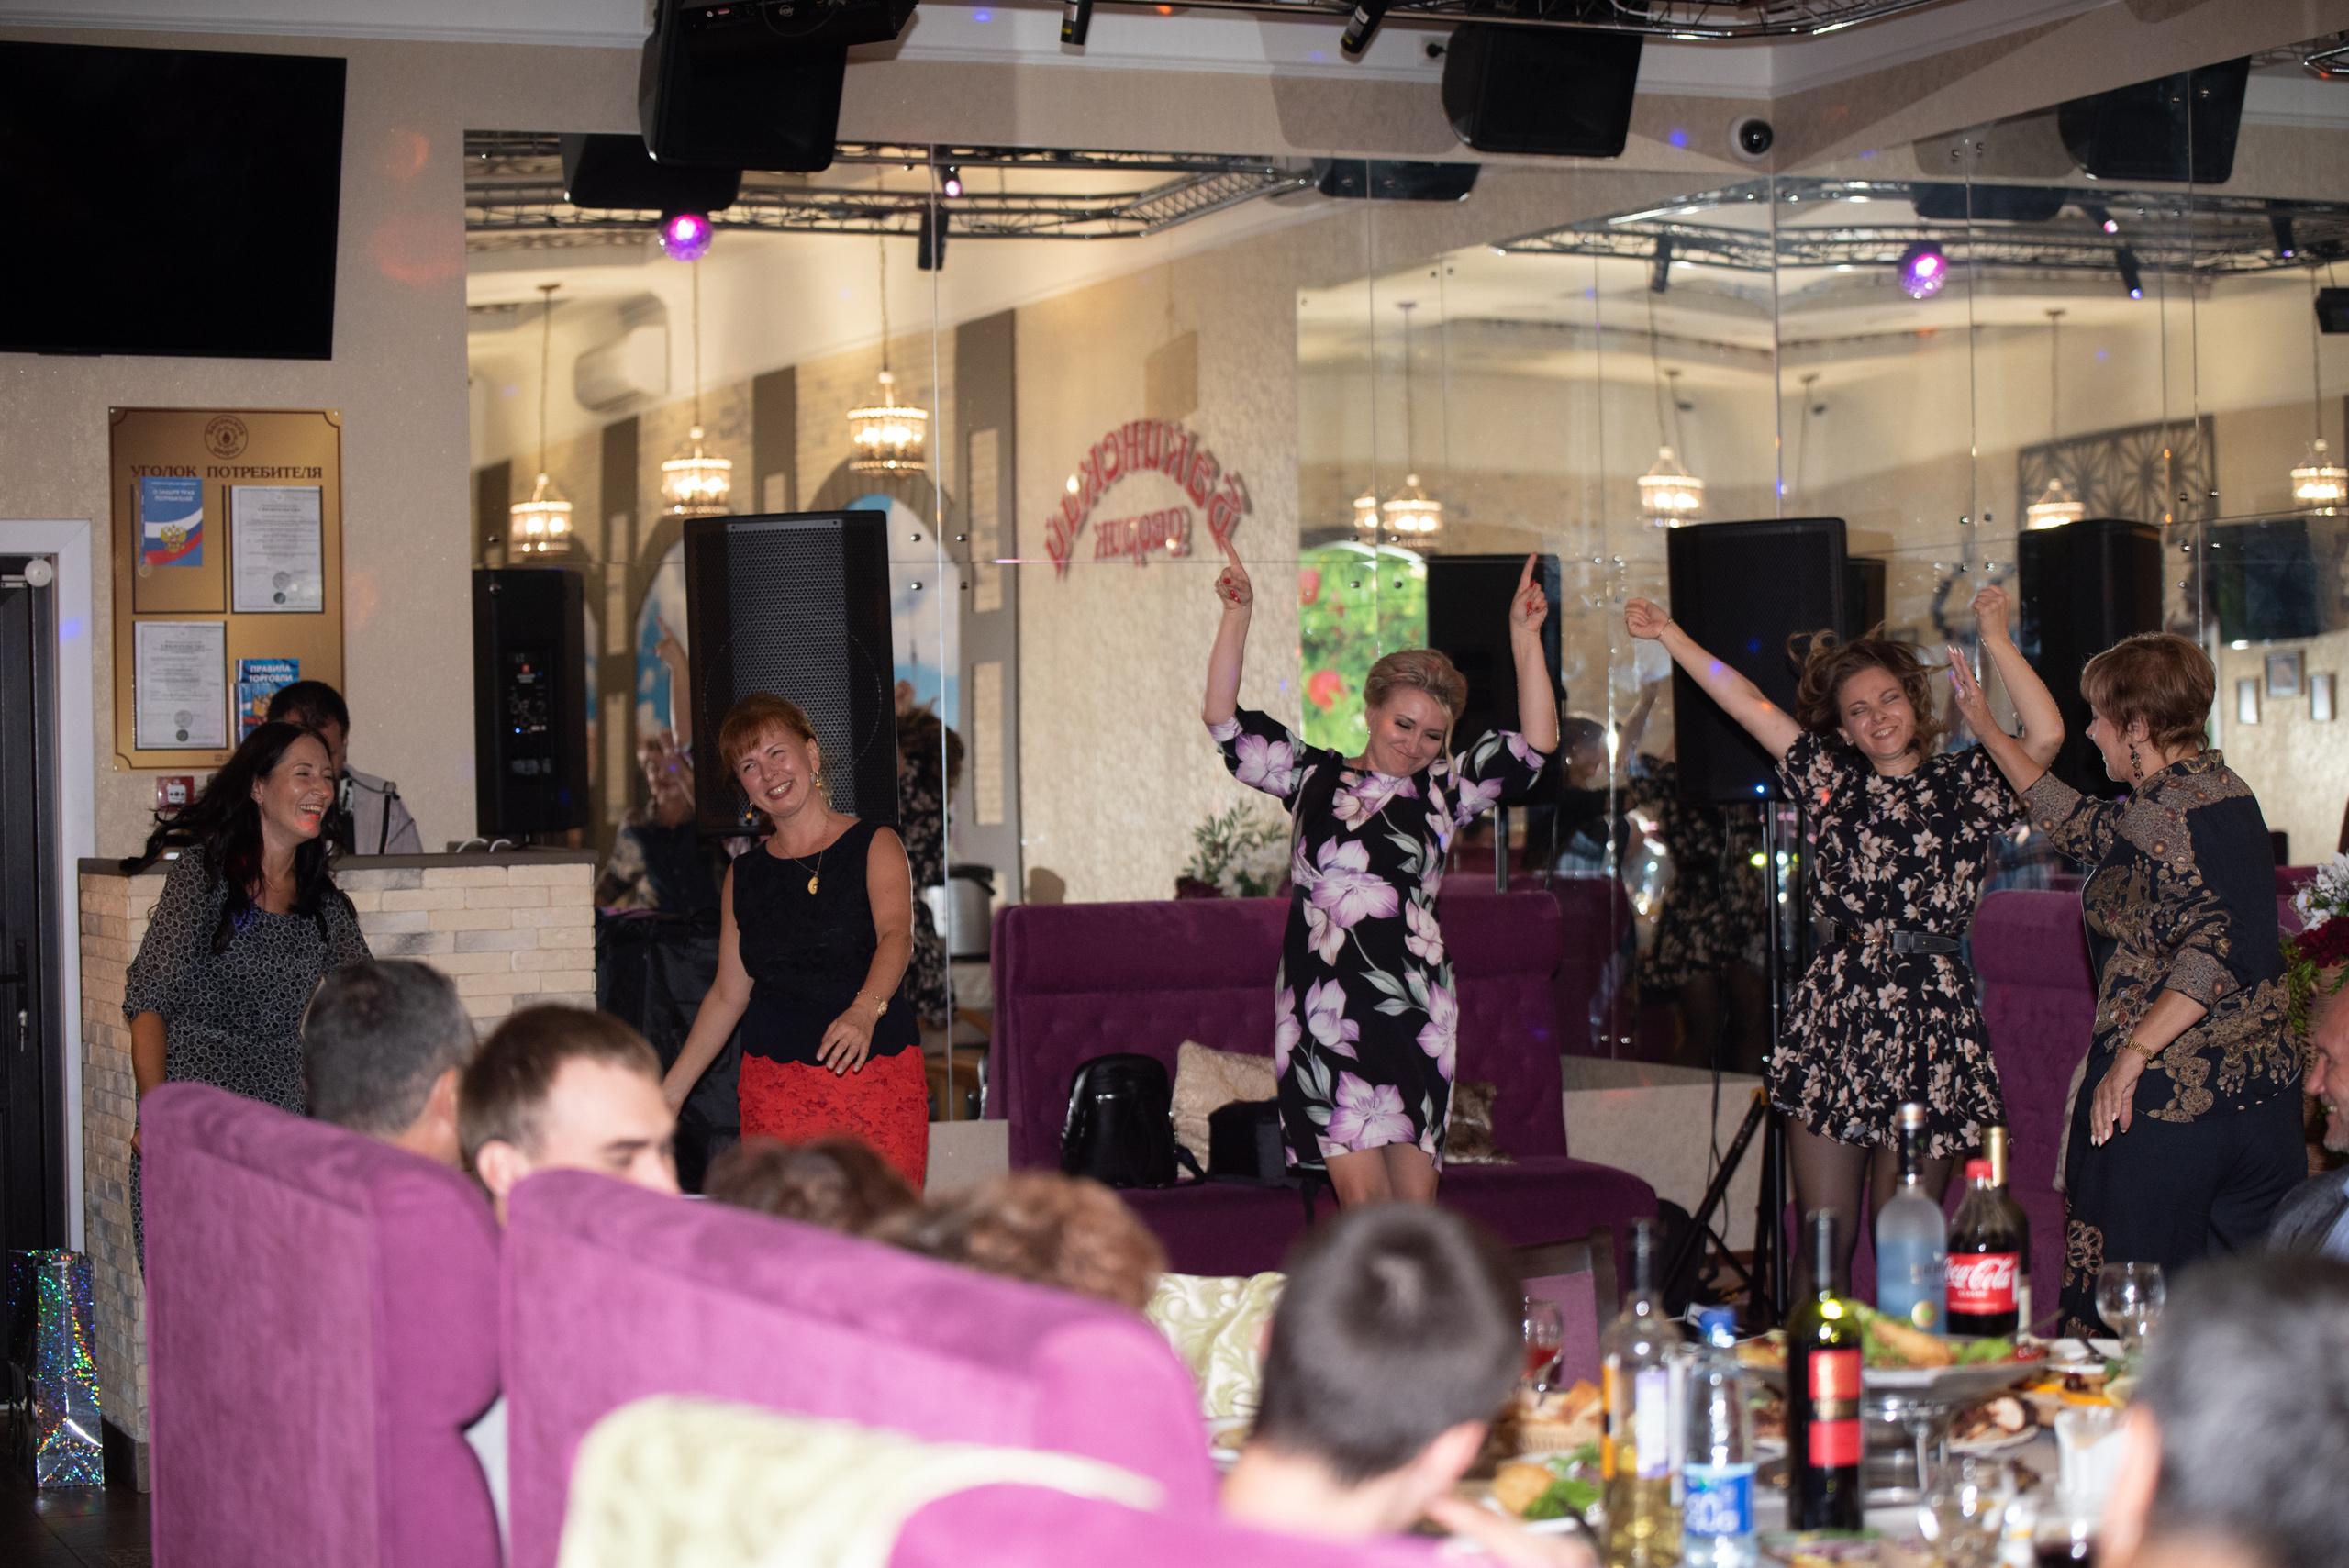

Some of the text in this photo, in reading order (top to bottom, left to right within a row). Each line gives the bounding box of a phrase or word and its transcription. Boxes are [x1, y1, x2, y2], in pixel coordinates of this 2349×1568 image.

[130, 465, 322, 478] УГОЛОК ПОТРЕБИТЕЛЯ
[250, 664, 292, 673] ПРАВИЛА
[249, 674, 294, 683] ТОРГОВЛИ
